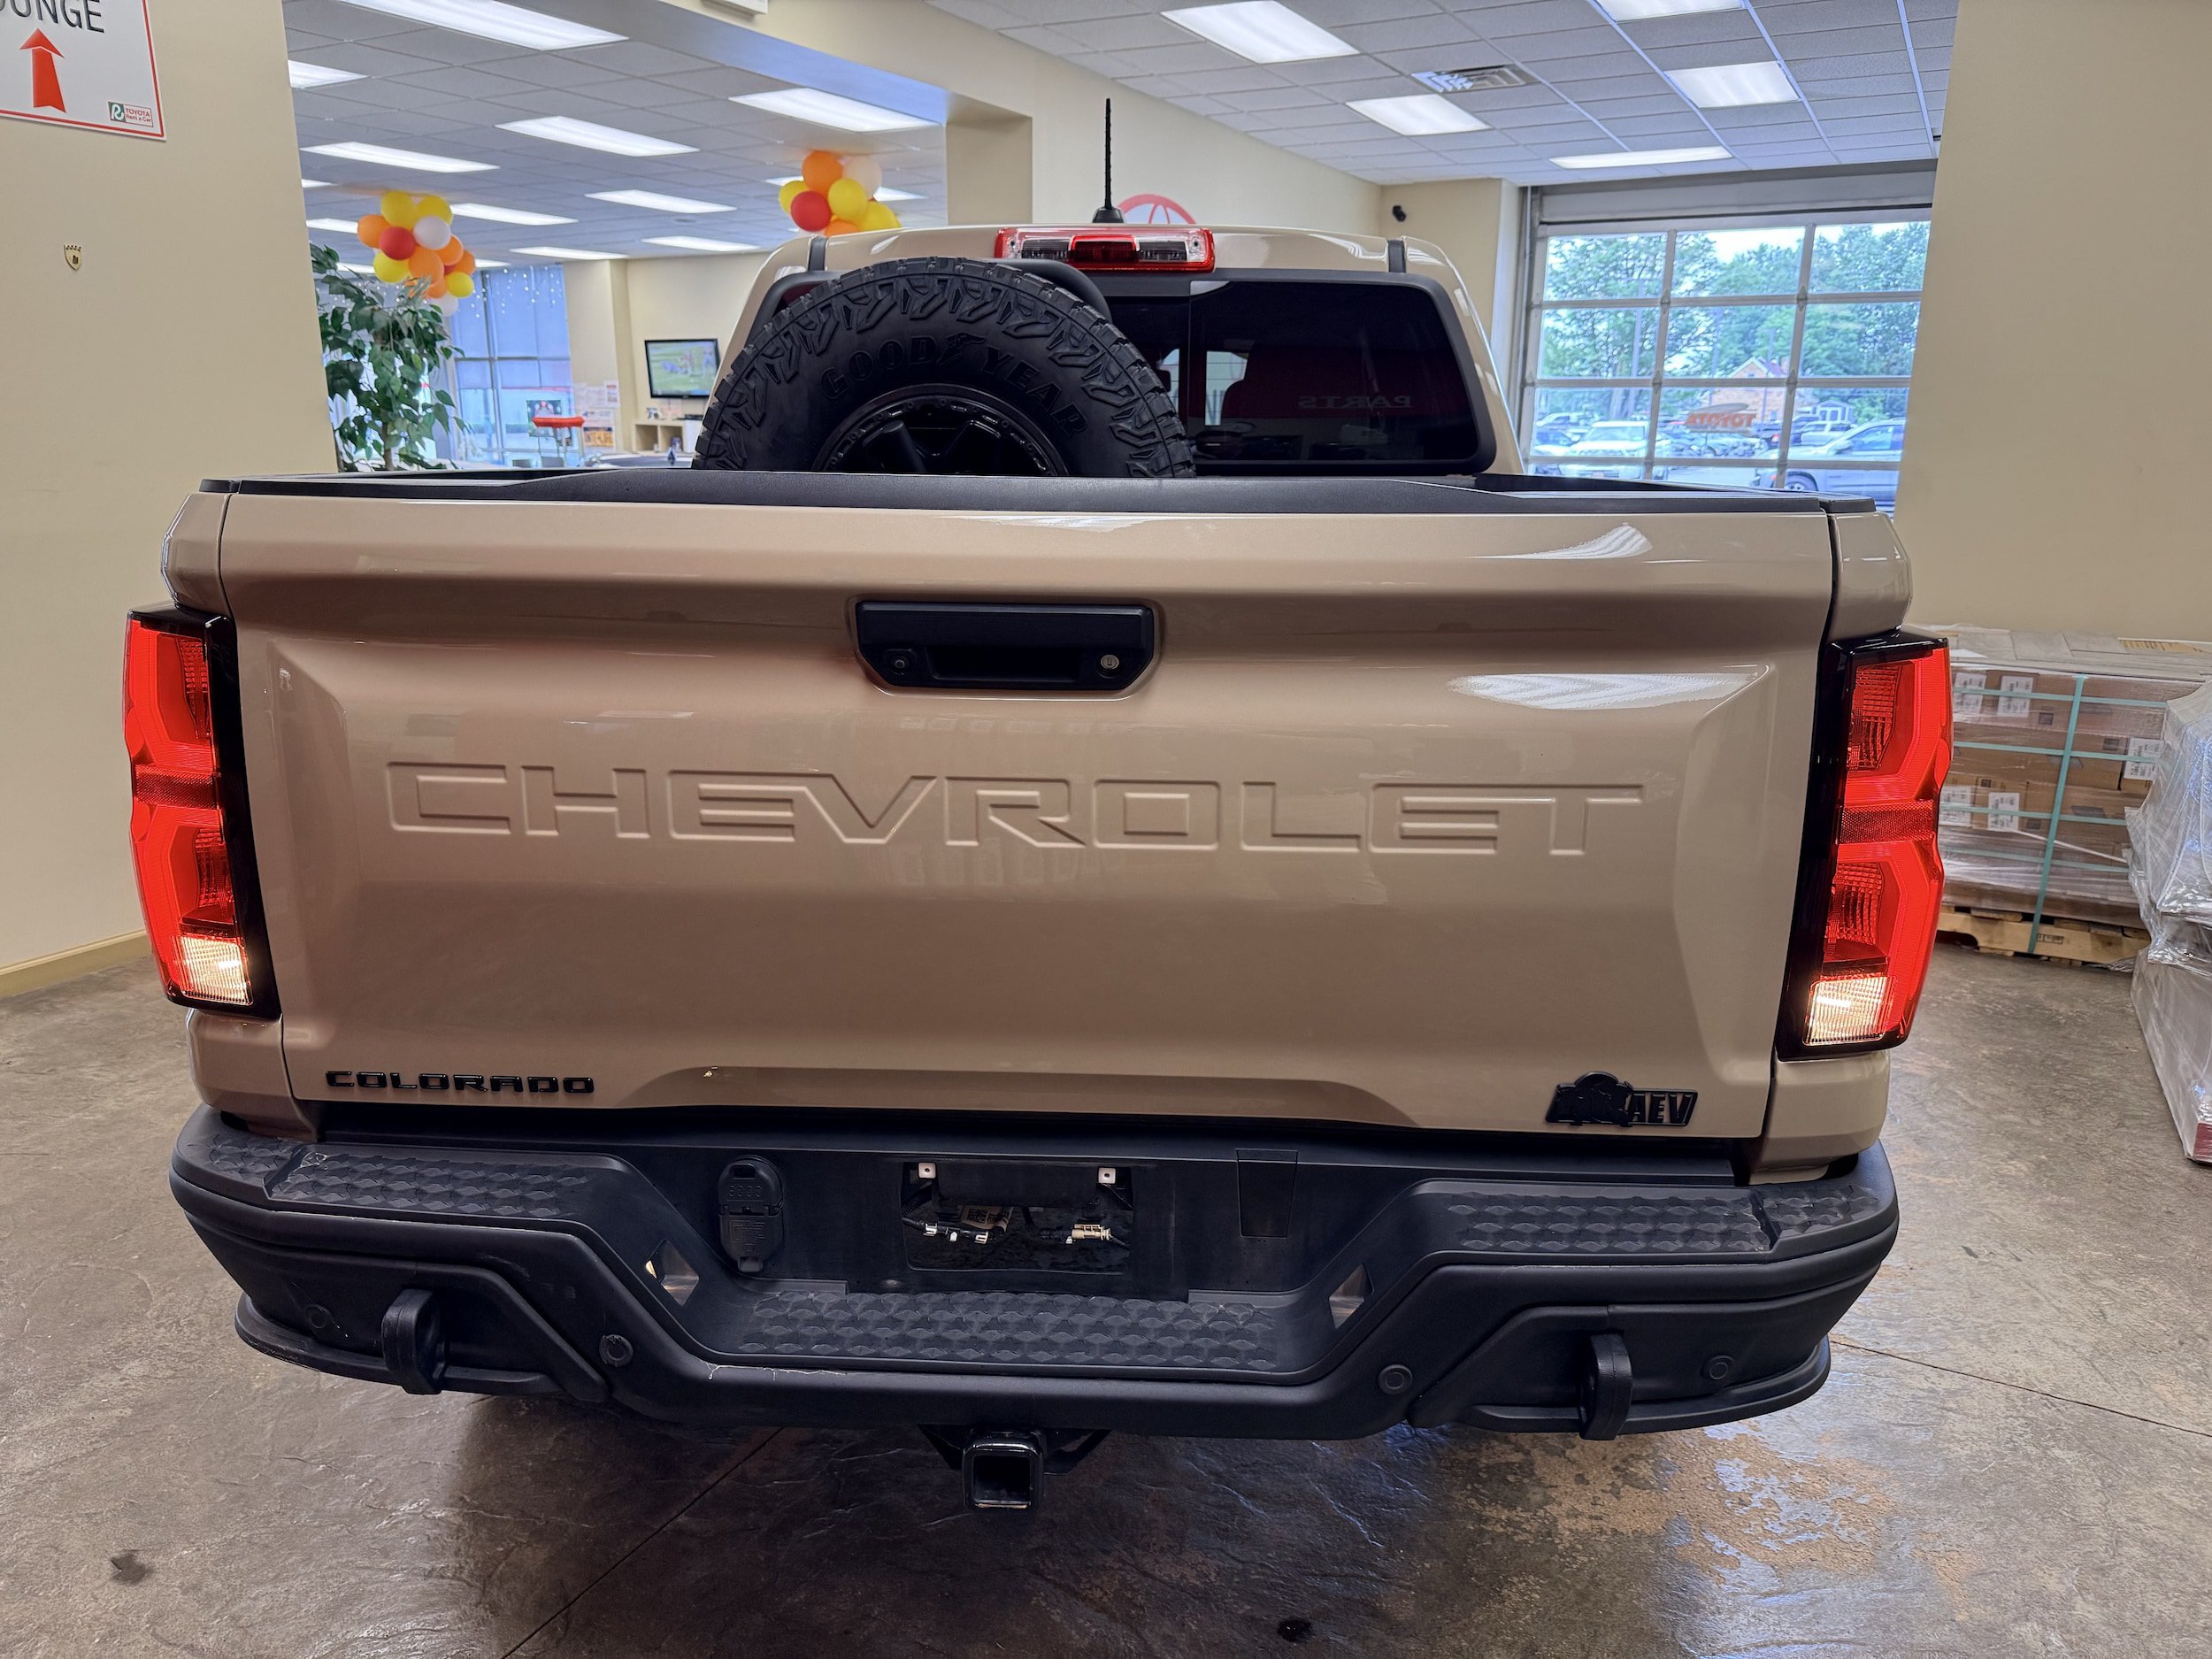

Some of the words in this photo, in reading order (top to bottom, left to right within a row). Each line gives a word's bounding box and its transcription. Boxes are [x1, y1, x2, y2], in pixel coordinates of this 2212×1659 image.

[0, 0, 104, 34] UNGE
[126, 108, 150, 117] TOYOTA
[820, 334, 938, 400] GOOD
[982, 345, 1088, 437] YEAR
[386, 761, 1645, 856] CHEVROLET
[325, 1070, 595, 1094] COLORADO
[1627, 1092, 1694, 1125] AEV
